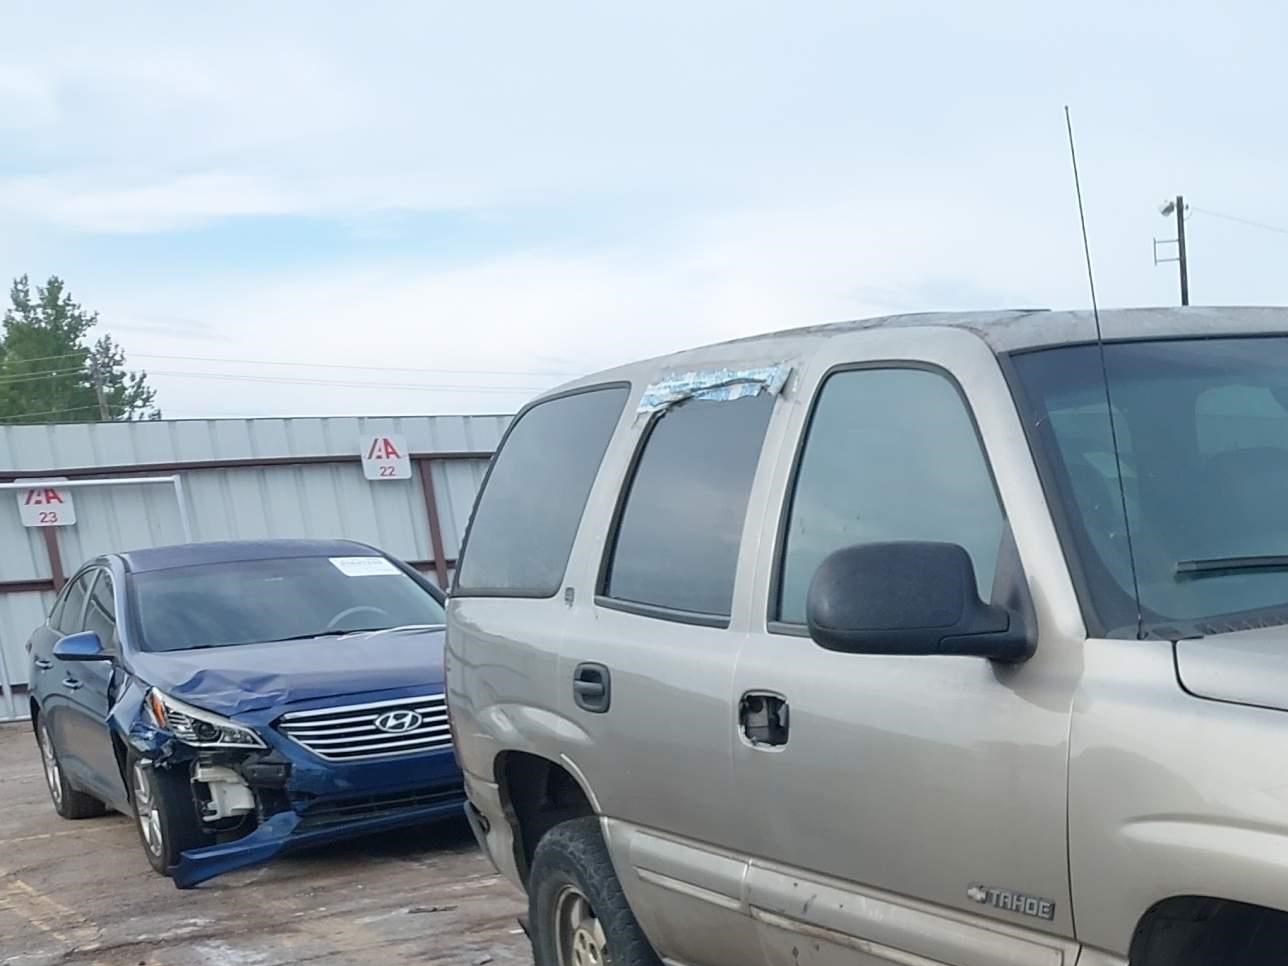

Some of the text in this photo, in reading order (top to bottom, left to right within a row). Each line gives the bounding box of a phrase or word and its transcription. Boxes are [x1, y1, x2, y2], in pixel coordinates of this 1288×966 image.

[379, 465, 397, 477] 22
[39, 511, 58, 523] 23
[989, 889, 1052, 919] TAHOE
